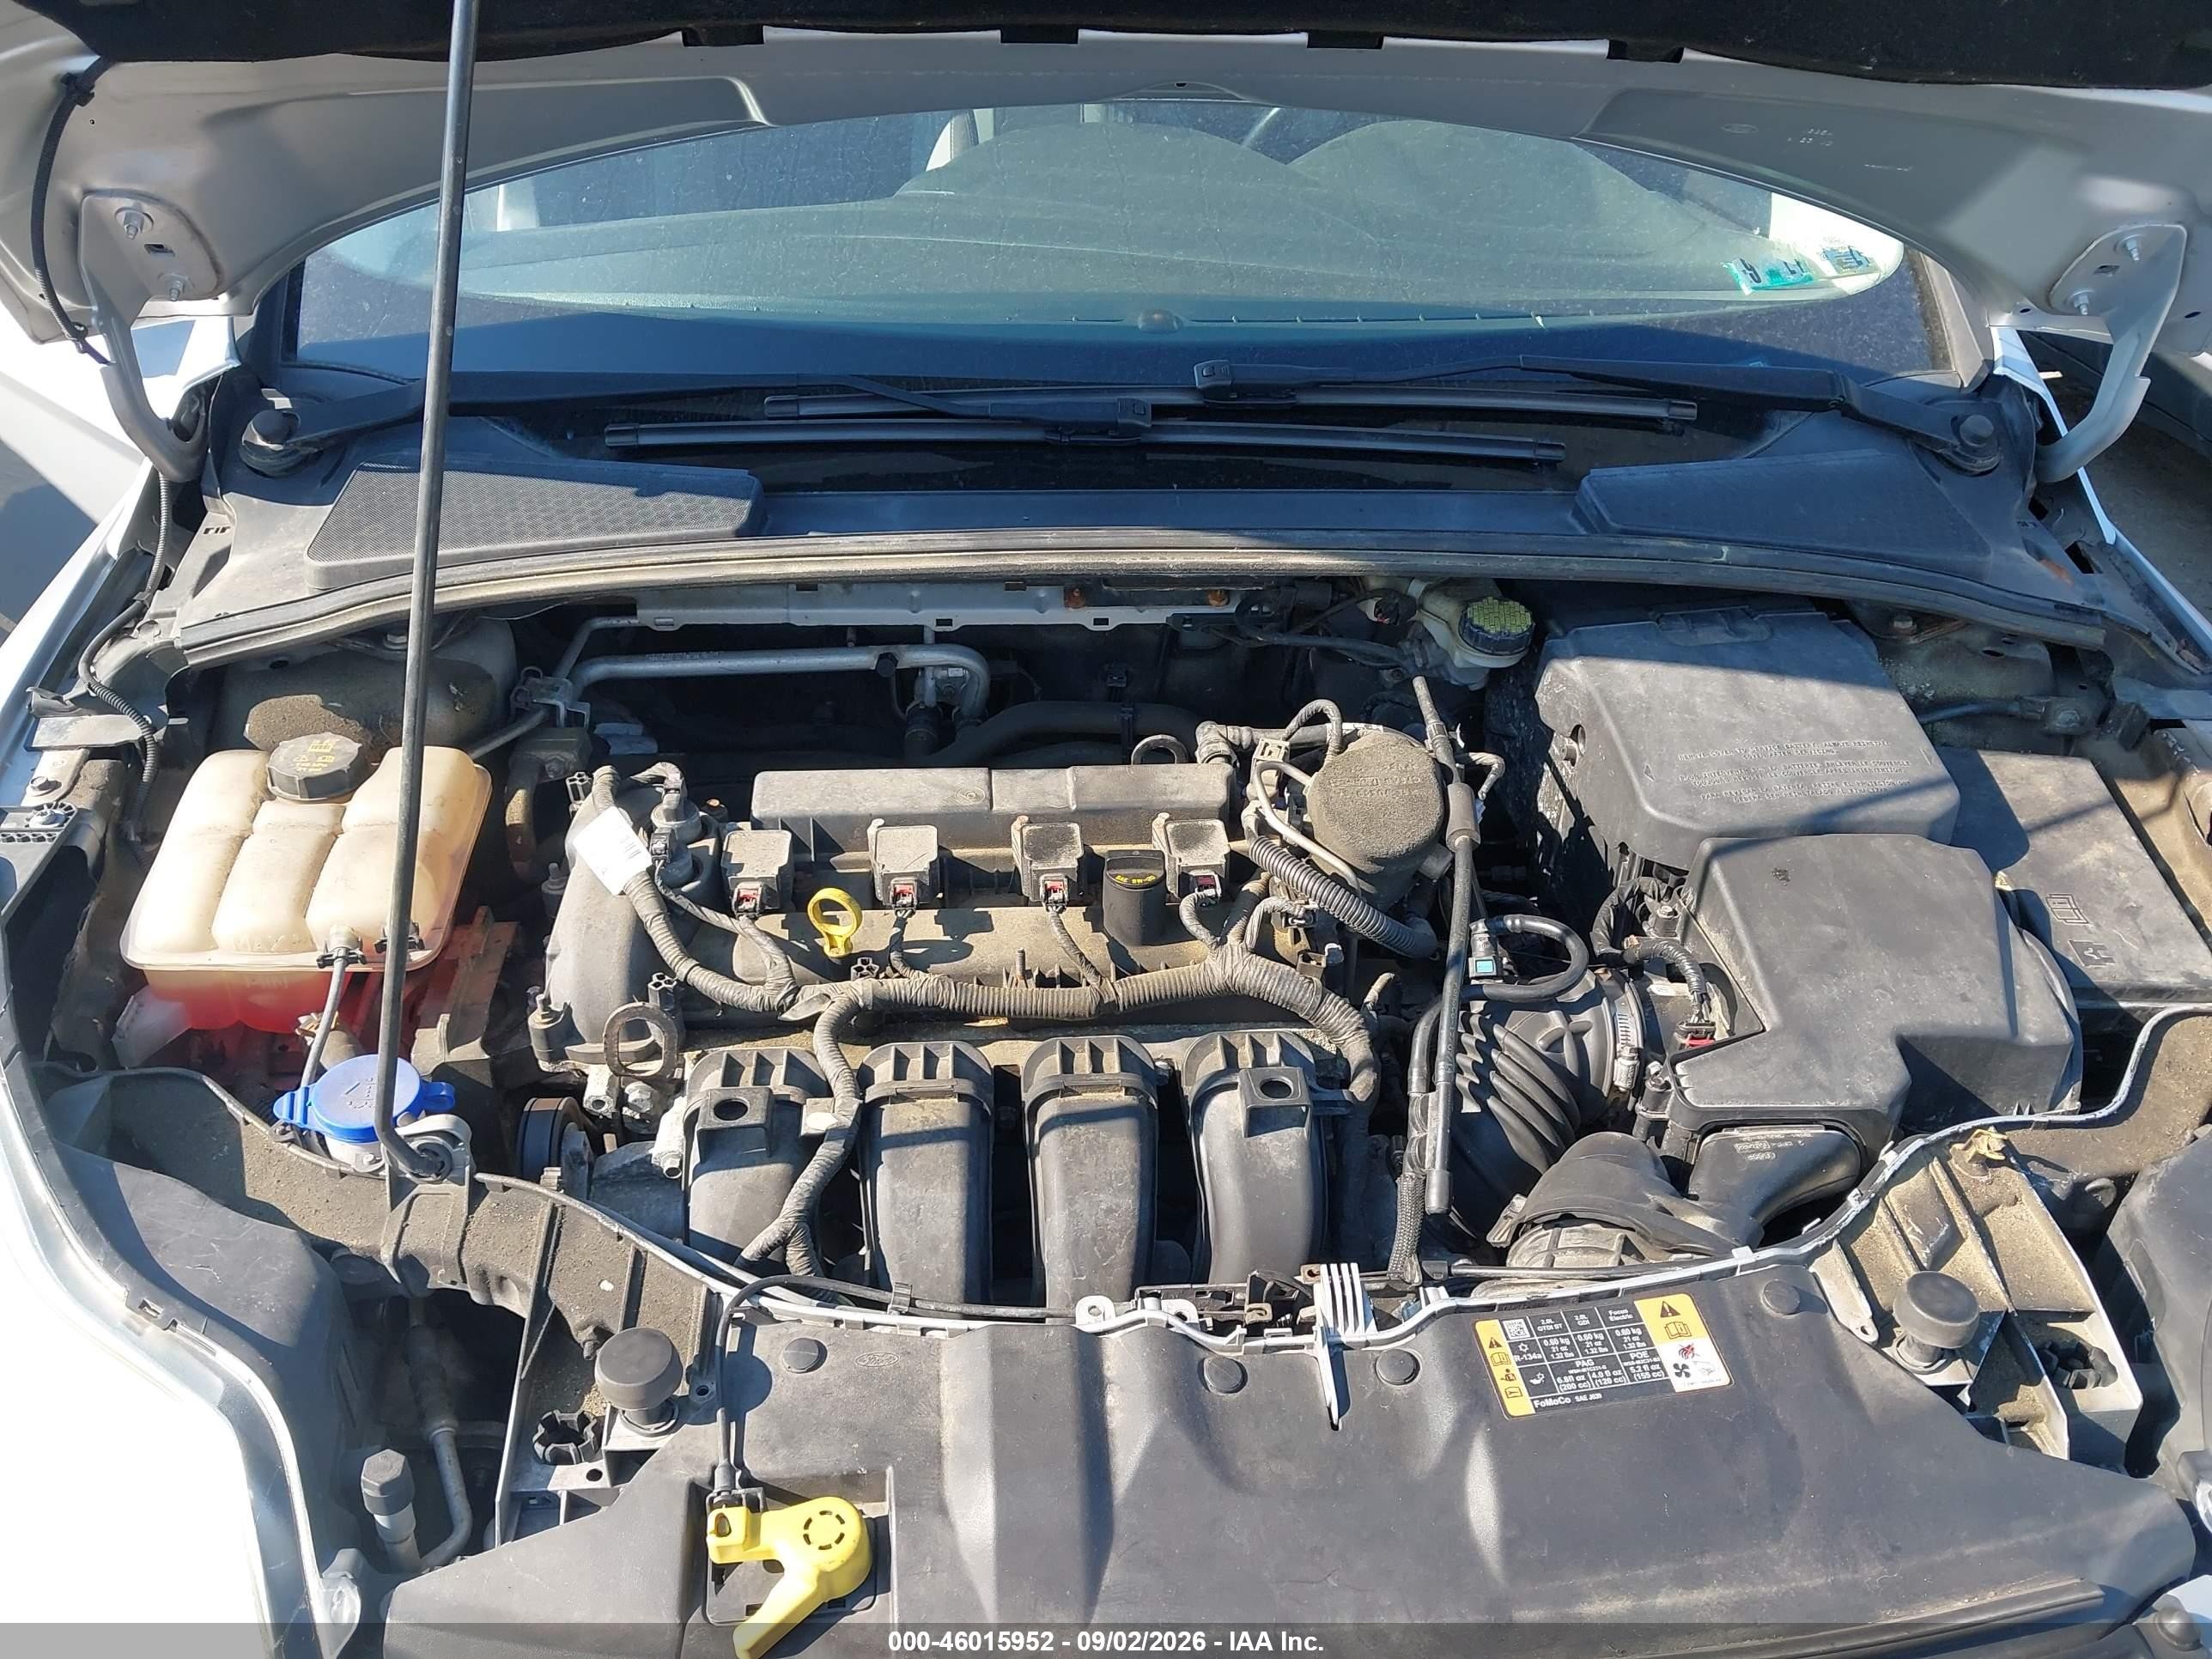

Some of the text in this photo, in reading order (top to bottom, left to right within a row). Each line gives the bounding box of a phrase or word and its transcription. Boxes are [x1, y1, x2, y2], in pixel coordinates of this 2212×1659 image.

[1608, 1313, 1634, 1322] Electric
[1577, 1332, 1604, 1342] 0.60 kg
[1614, 1327, 1643, 1337] 0.60 kg
[1543, 1337, 1571, 1346] 0.60 kg
[1513, 1352, 1543, 1362] R-134a
[1629, 1351, 1650, 1360] POE
[1575, 1358, 1595, 1368] PAG
[1591, 1370, 1603, 1379] 4.0
[1629, 1365, 1642, 1374] 5.2
[1633, 1369, 1665, 1382] (155 cc)
[1559, 1380, 1591, 1392] (200 cc)
[1595, 1375, 1626, 1388] (120 cc)
[1533, 1396, 1571, 1408] FoMoCo
